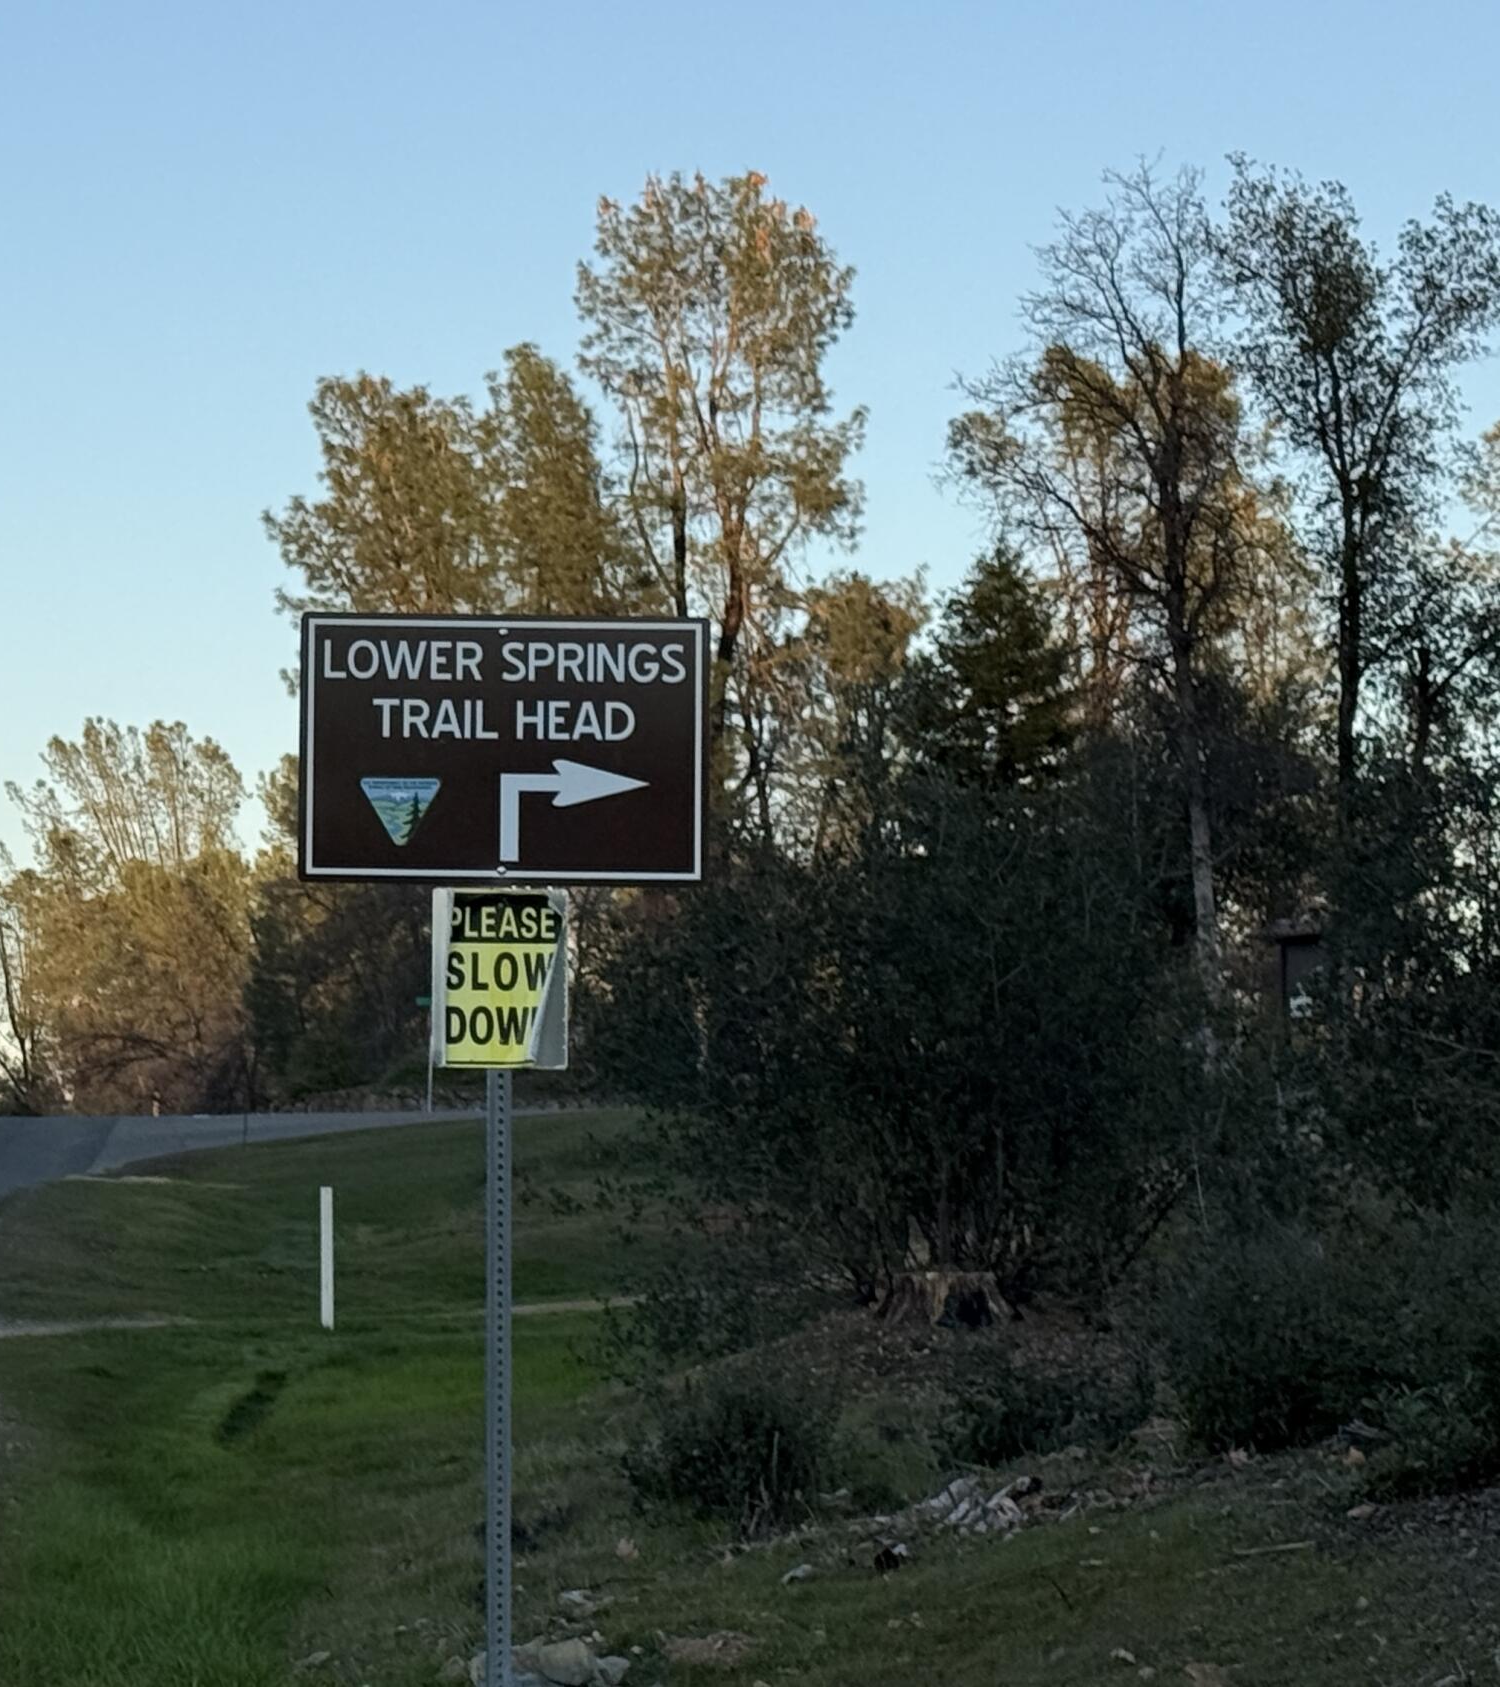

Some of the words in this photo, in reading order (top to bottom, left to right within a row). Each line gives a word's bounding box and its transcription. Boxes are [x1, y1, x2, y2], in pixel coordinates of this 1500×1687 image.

[323, 639, 483, 681] LOWER
[501, 642, 687, 684] SPRINGS
[372, 698, 499, 740] TRAIL
[516, 700, 636, 741] HEAD
[446, 951, 554, 991] SLOW
[446, 1006, 539, 1046] DOW
